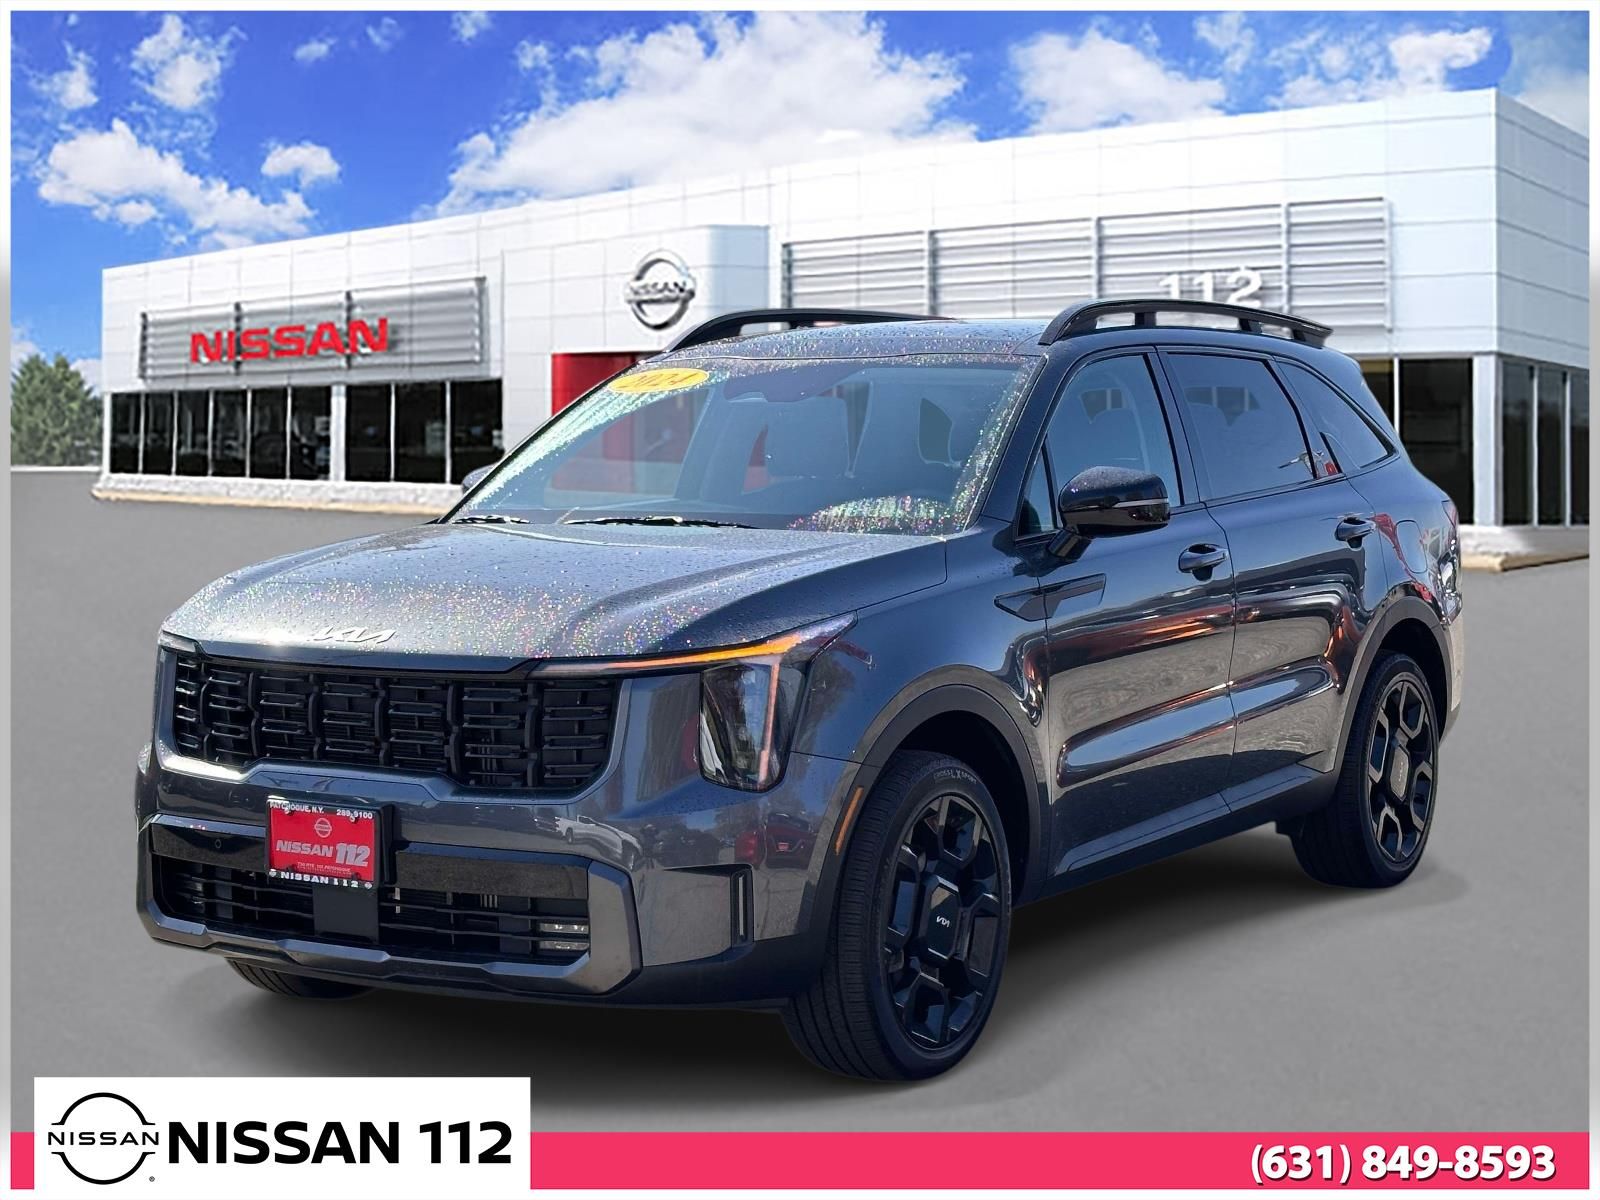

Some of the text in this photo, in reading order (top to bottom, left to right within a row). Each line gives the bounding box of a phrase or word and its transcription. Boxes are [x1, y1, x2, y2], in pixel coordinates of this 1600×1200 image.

[1159, 269, 1261, 309] 112
[190, 317, 388, 363] NISSAN
[336, 808, 373, 820] 2899100
[276, 839, 371, 868] NISSAN 112
[280, 871, 329, 885] NISSAN
